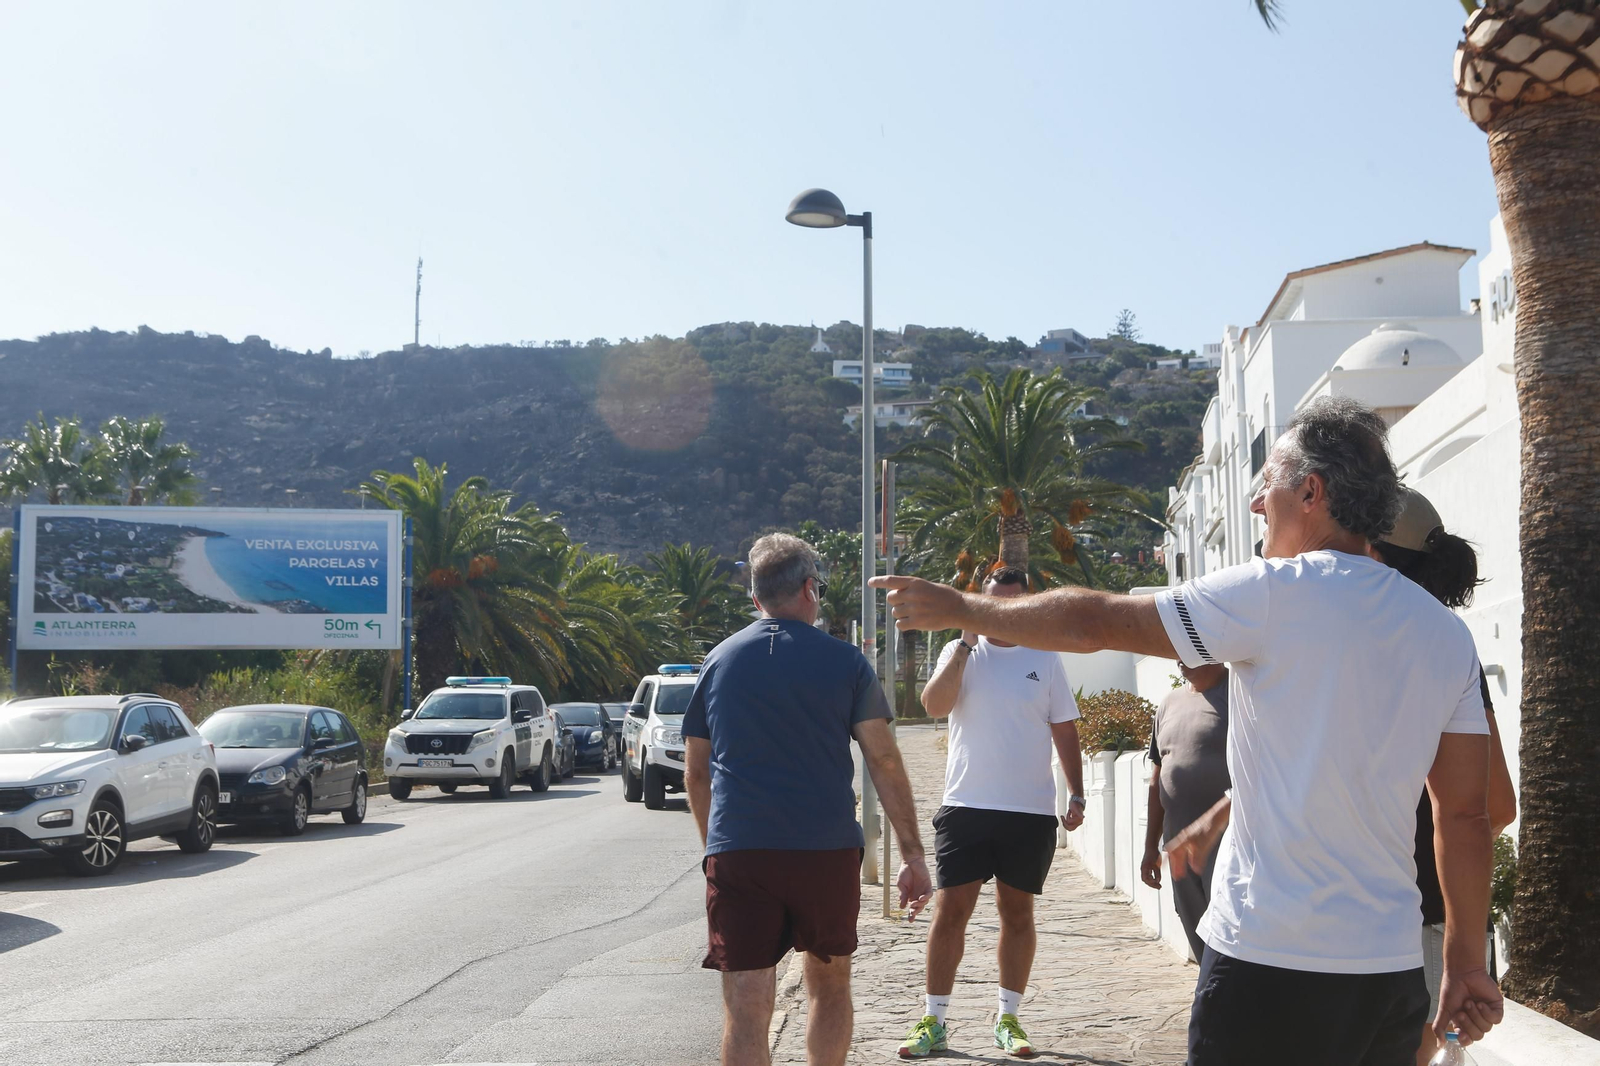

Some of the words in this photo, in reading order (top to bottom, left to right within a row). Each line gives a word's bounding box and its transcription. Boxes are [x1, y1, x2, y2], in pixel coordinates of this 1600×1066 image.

[245, 539, 293, 550] VENTA
[296, 540, 379, 551] EXCLUSIVA
[289, 557, 366, 569] PARCELAS
[369, 558, 379, 569] Y
[325, 576, 379, 587] VILLAS
[51, 621, 137, 630] ATLANTERRA
[324, 618, 359, 631] 50m
